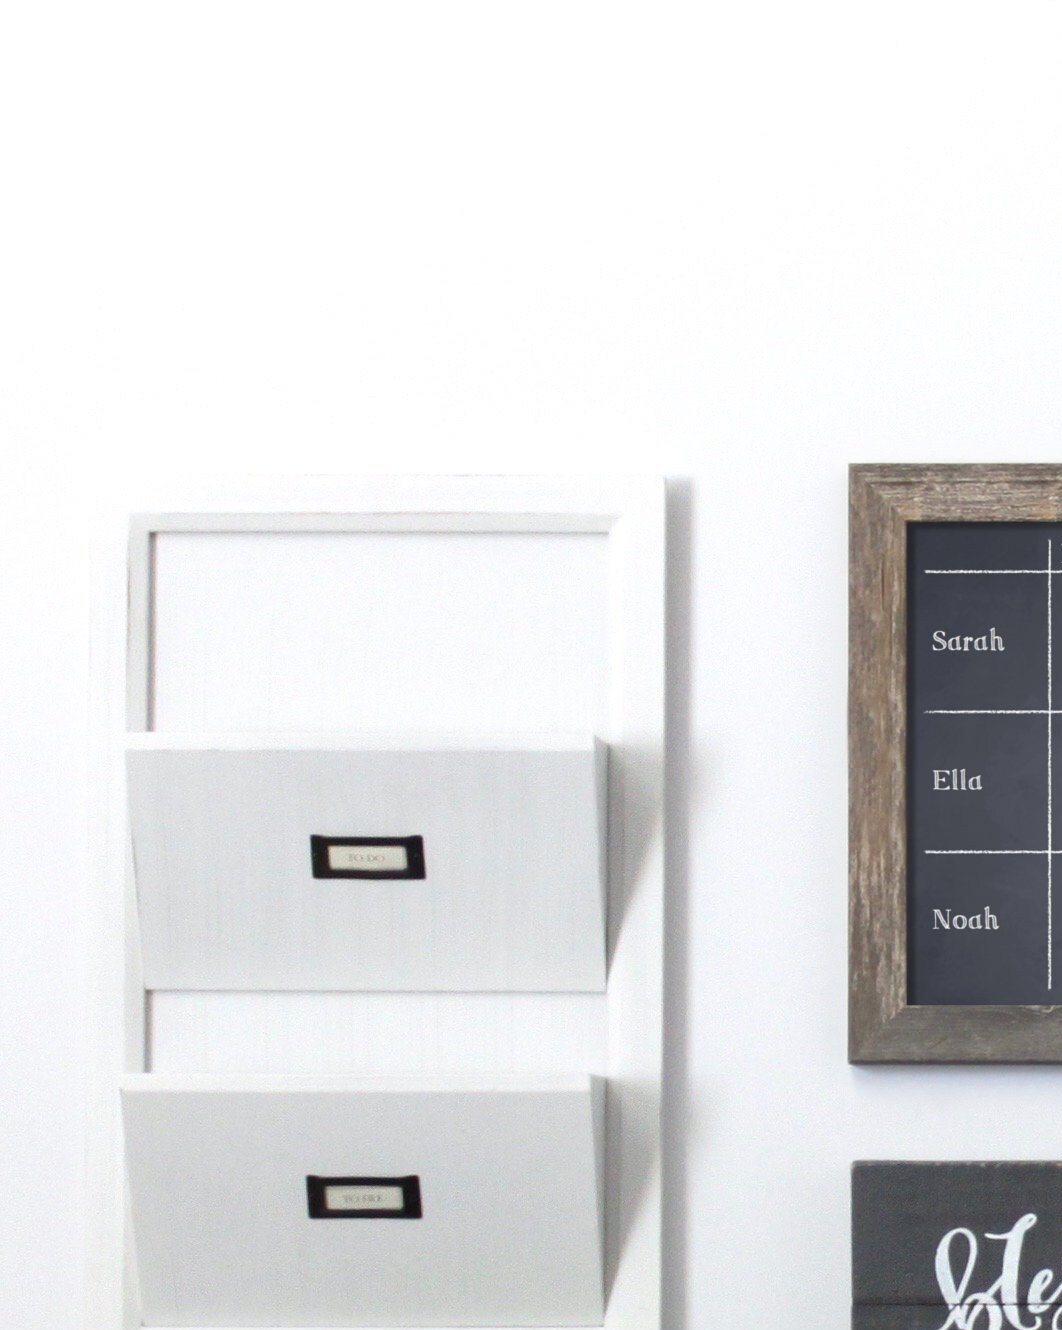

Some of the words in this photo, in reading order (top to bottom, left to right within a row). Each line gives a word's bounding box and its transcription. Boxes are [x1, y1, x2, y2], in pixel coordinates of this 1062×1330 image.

[932, 627, 1006, 652] Sarah
[932, 769, 983, 791] Ella
[932, 906, 1000, 930] Noah
